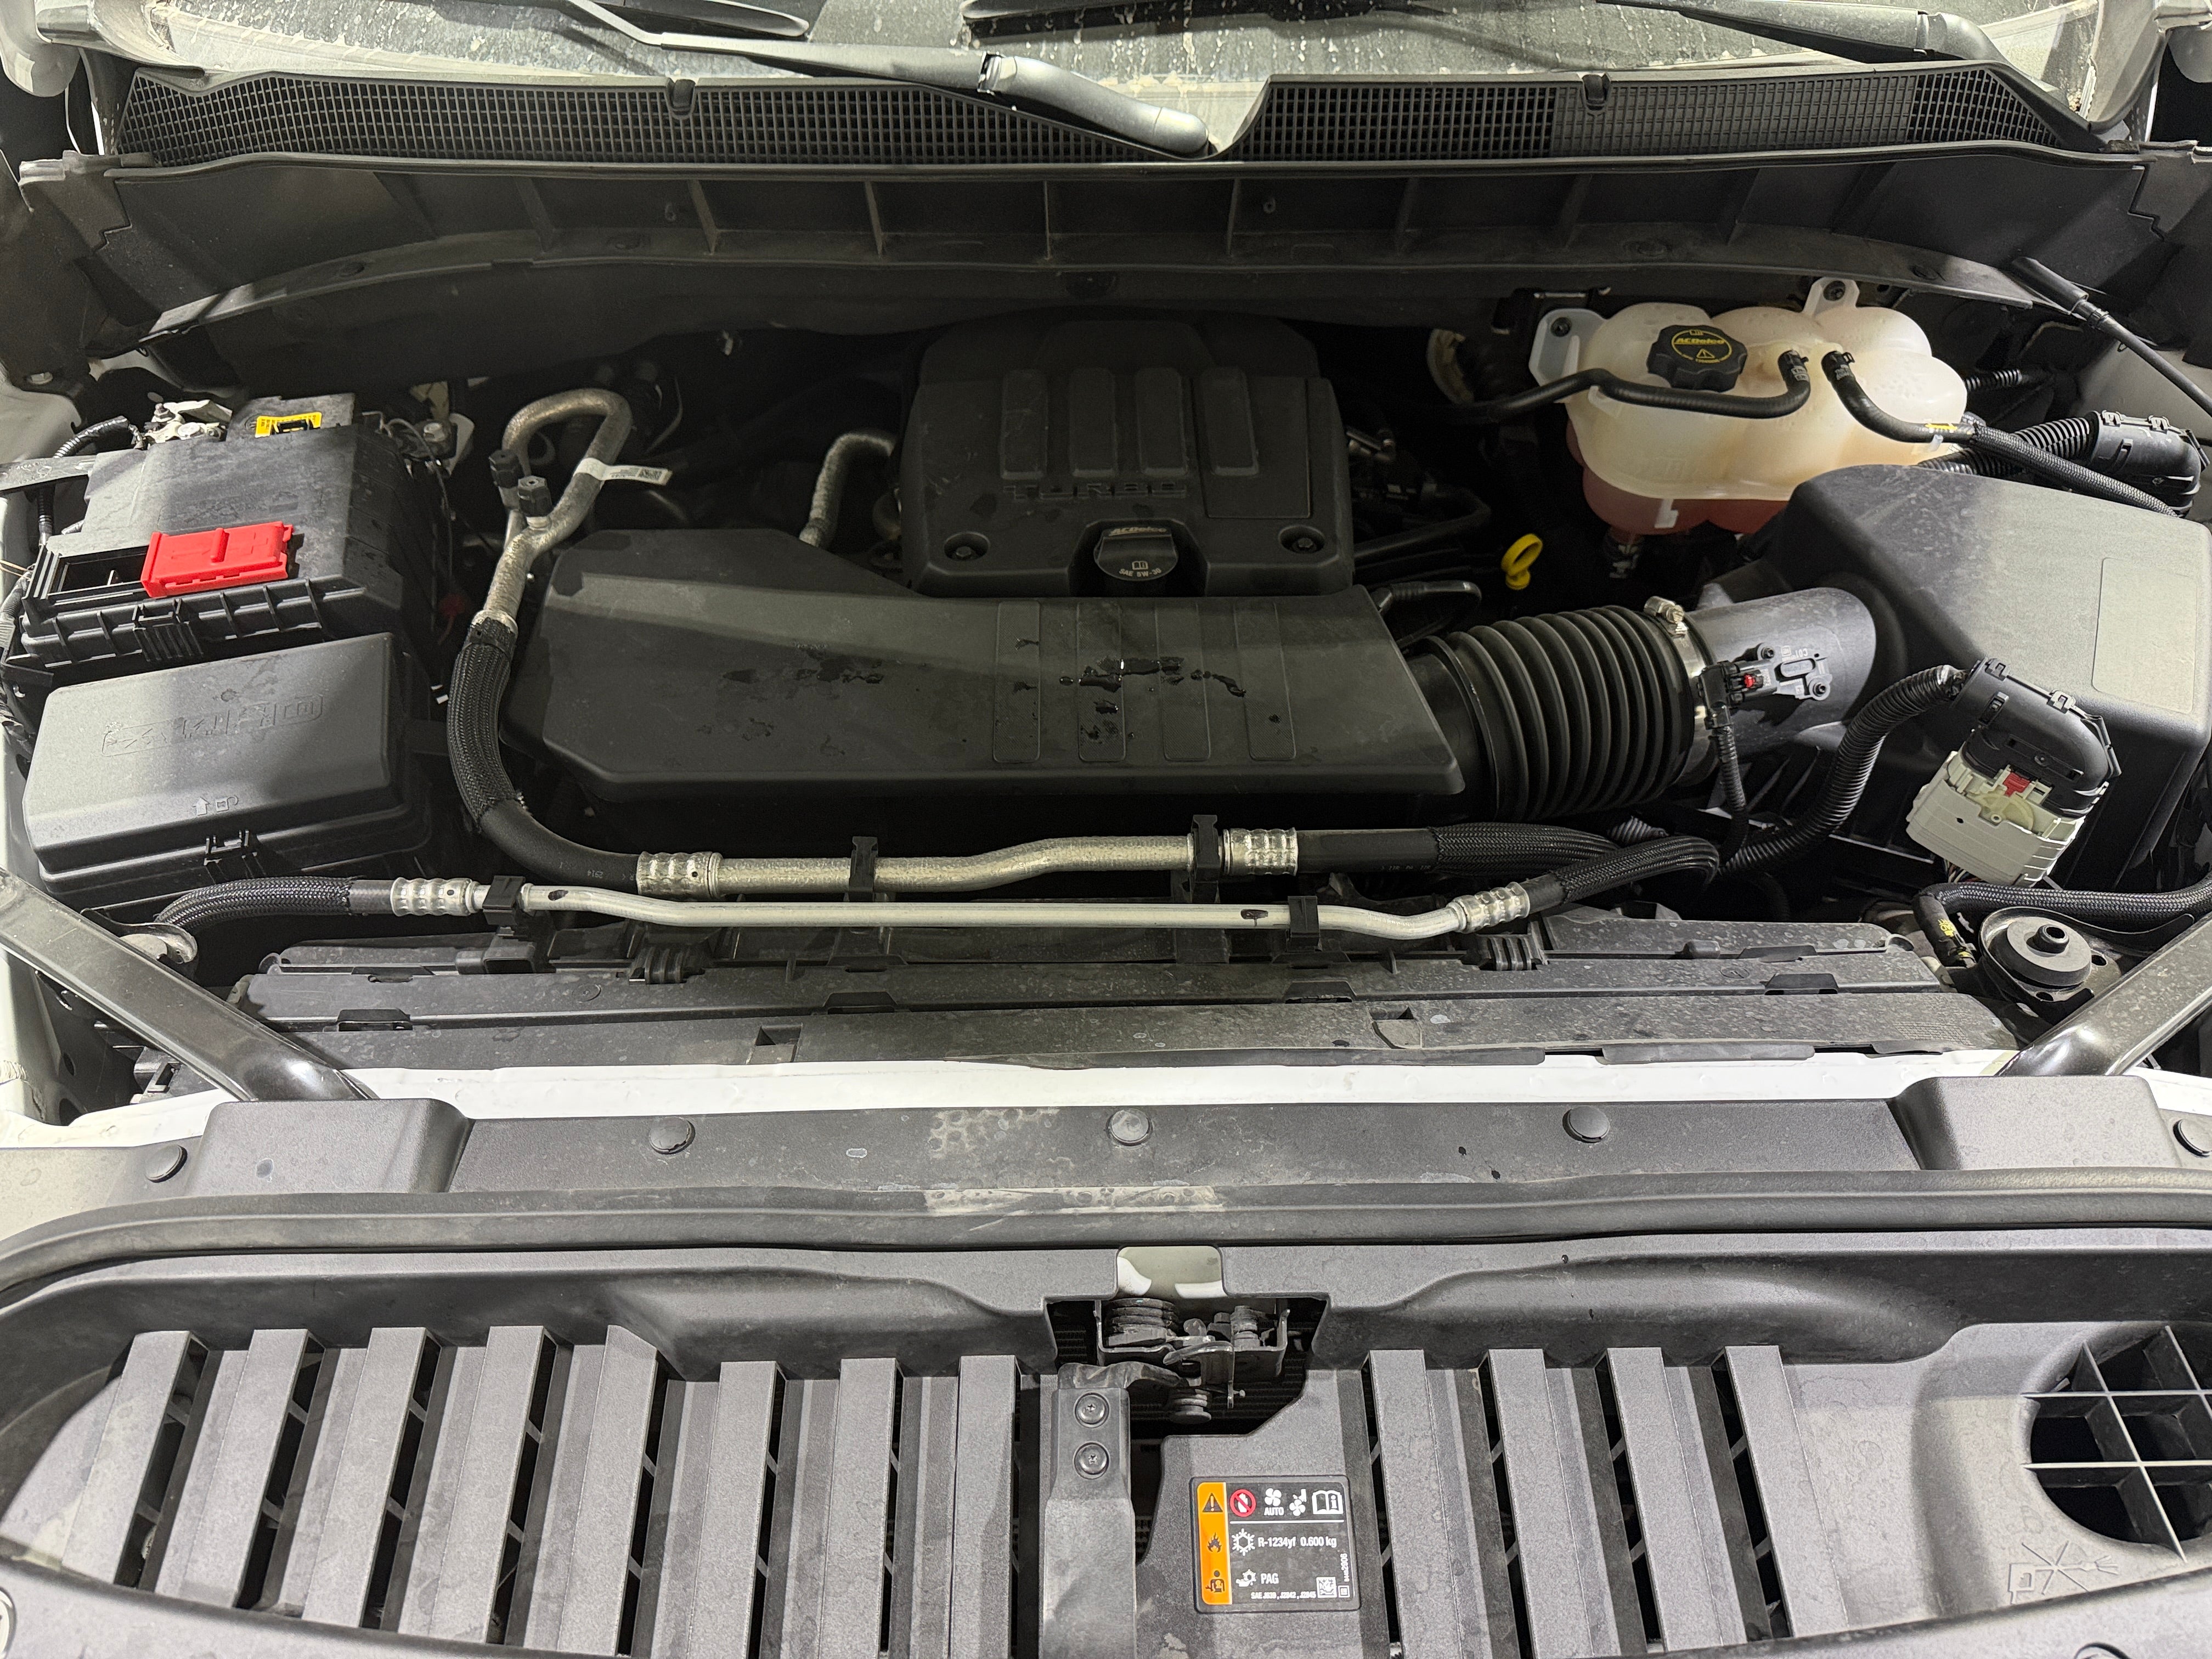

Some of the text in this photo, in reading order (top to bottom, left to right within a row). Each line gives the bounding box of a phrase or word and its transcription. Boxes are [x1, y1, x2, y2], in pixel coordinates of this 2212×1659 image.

[1119, 568, 1162, 577] SAE 5W-30
[1264, 1506, 1284, 1516] AUTO
[1258, 1536, 1337, 1549] R-1234yf 0.600 kg
[1261, 1573, 1279, 1584] PAG
